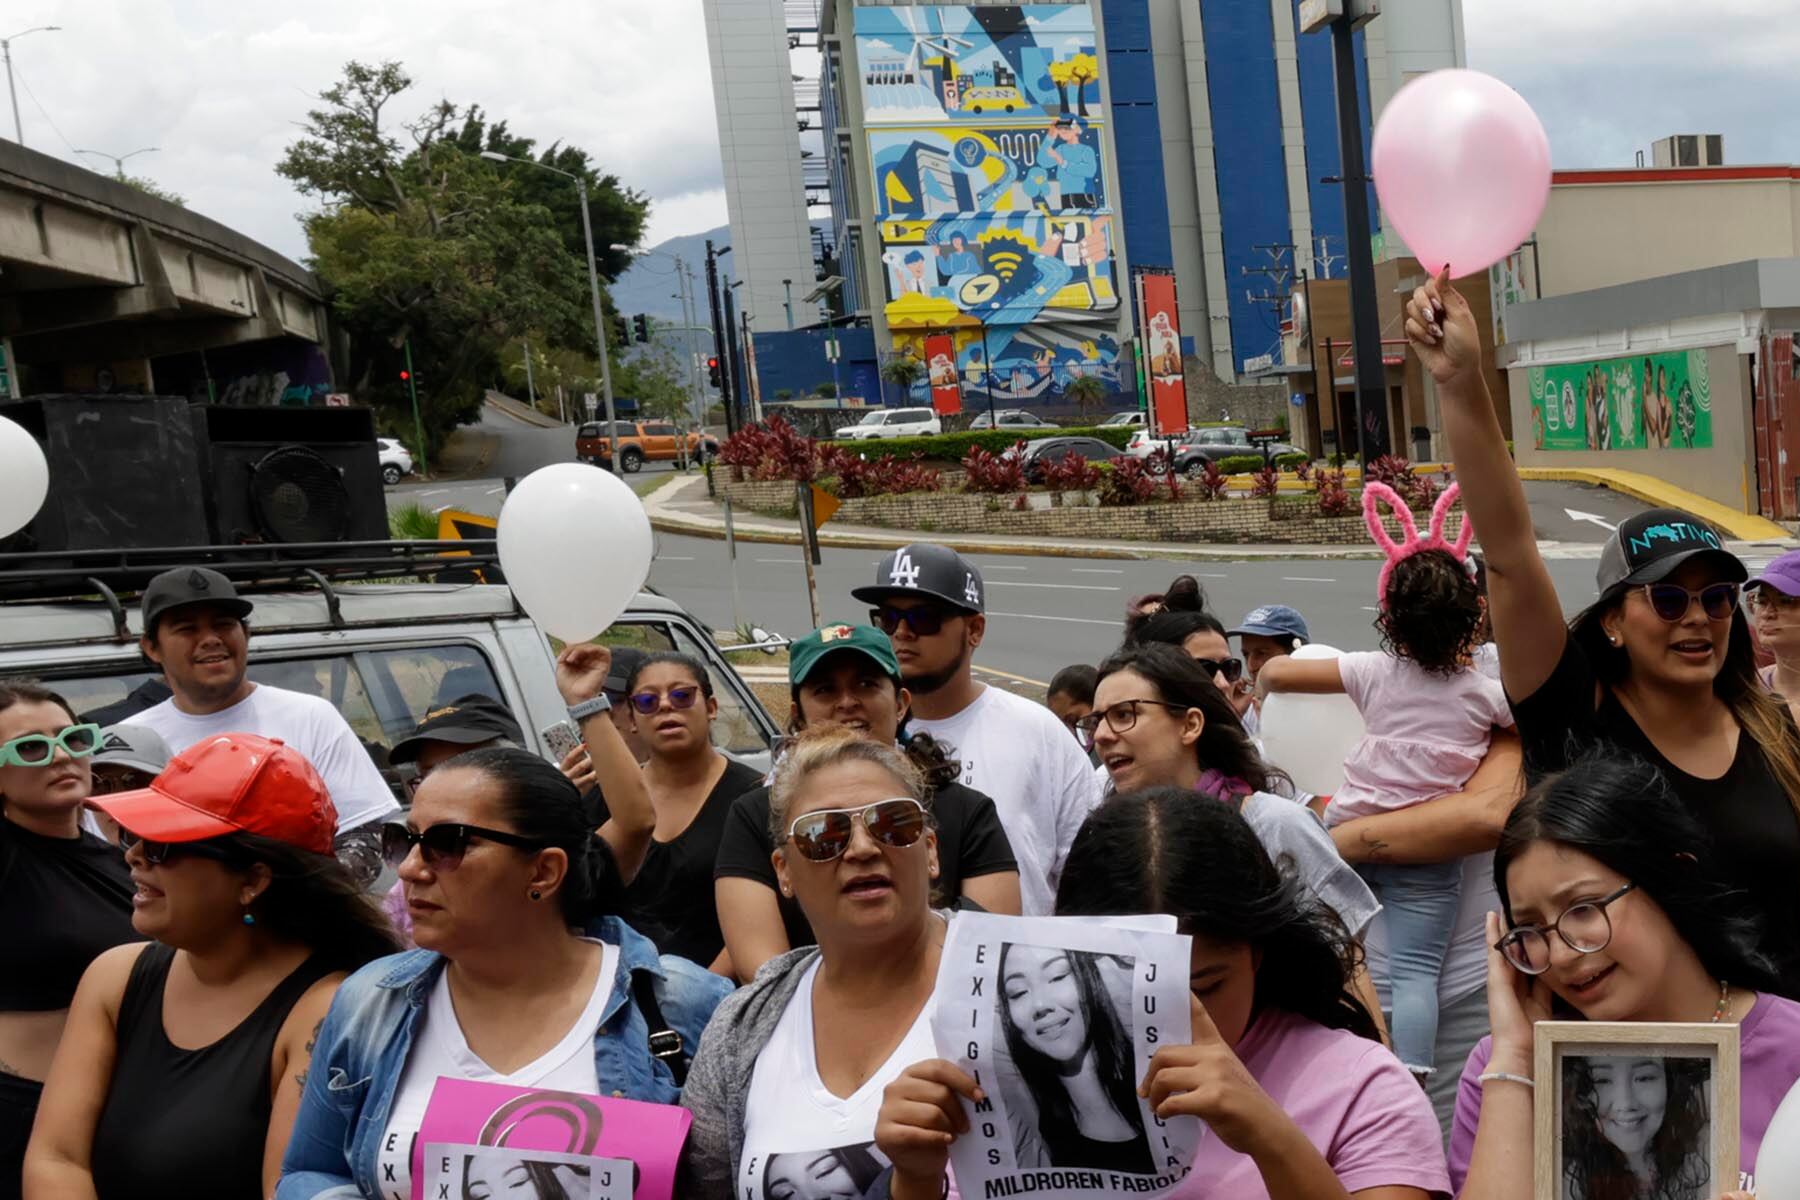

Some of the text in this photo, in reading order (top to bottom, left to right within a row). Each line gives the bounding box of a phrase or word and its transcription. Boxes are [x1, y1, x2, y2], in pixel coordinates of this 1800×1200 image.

[1629, 522, 1719, 555] NTIVO
[889, 547, 920, 588] LA
[964, 571, 980, 604] LA
[1143, 963, 1180, 1168] JUSCIA
[984, 1171, 1104, 1200] MILDROREN
